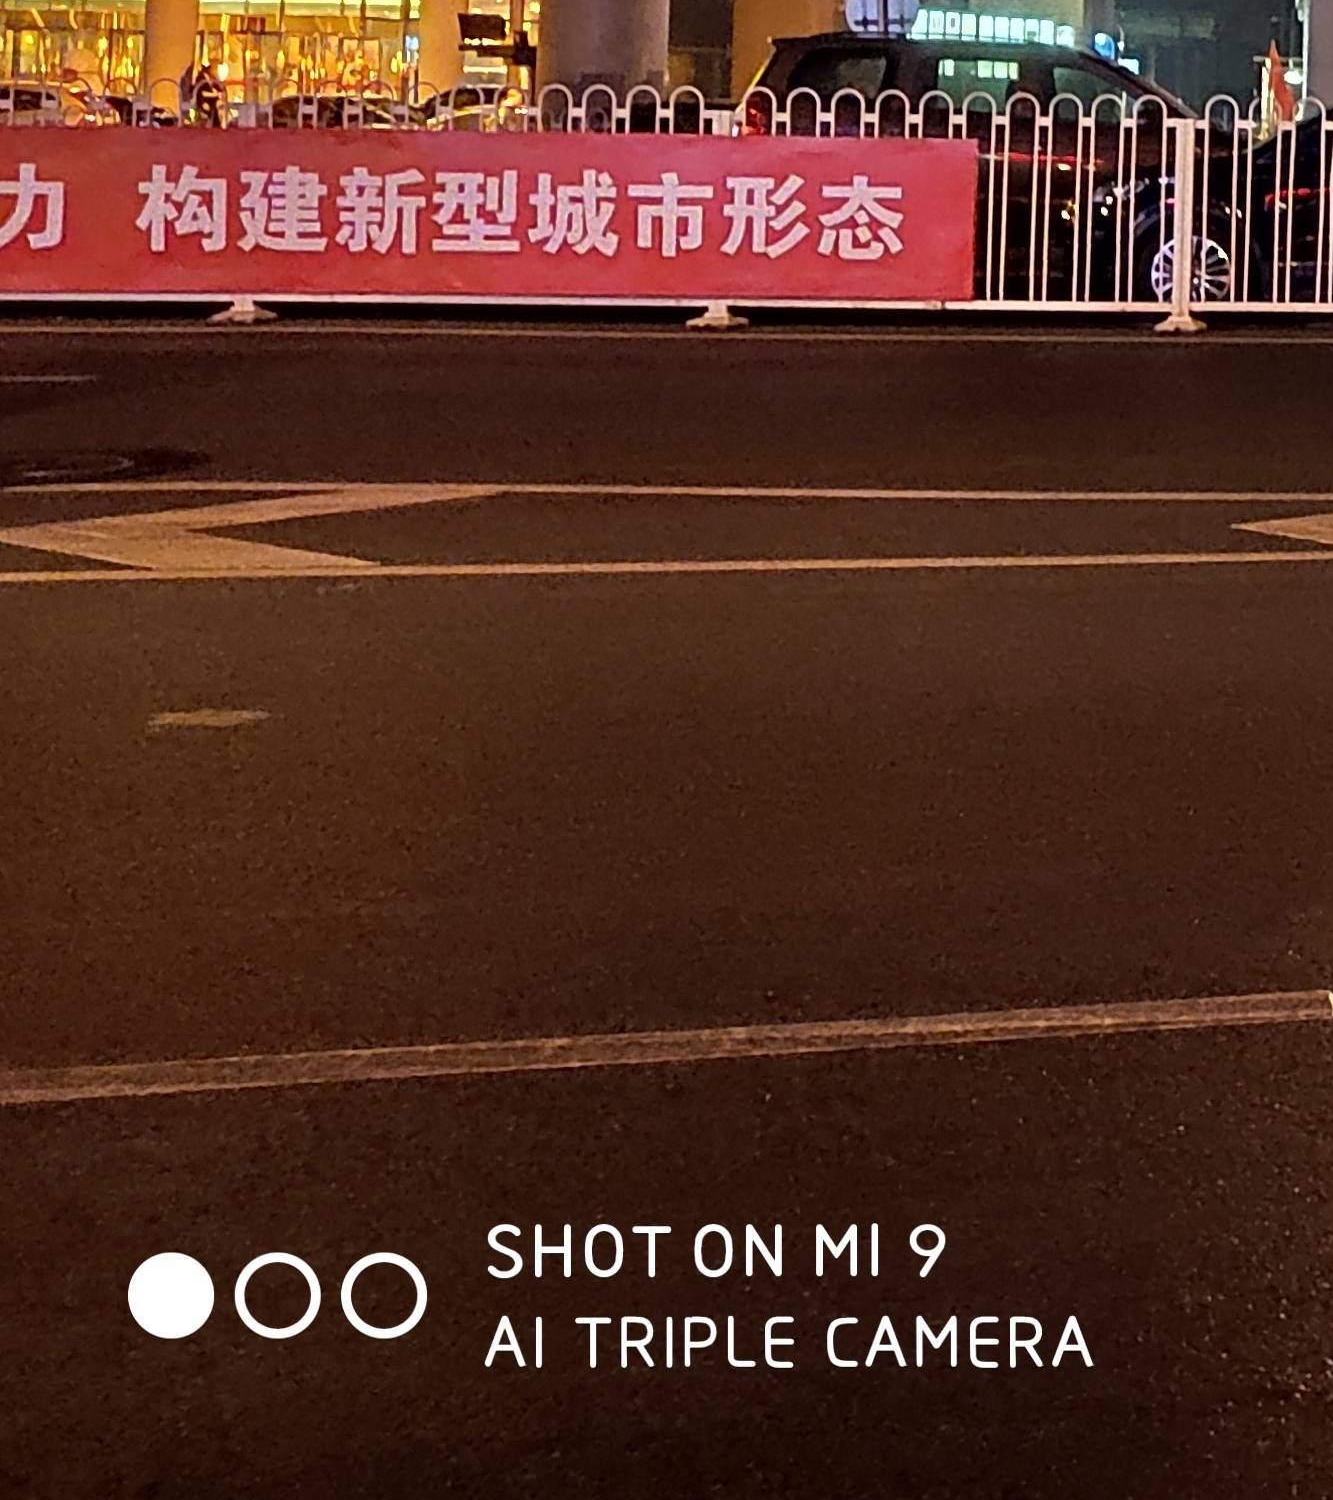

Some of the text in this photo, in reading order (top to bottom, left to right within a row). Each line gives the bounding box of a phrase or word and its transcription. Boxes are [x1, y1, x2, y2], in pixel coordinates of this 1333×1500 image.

[0, 163, 904, 261] 力 构建新型城市形态
